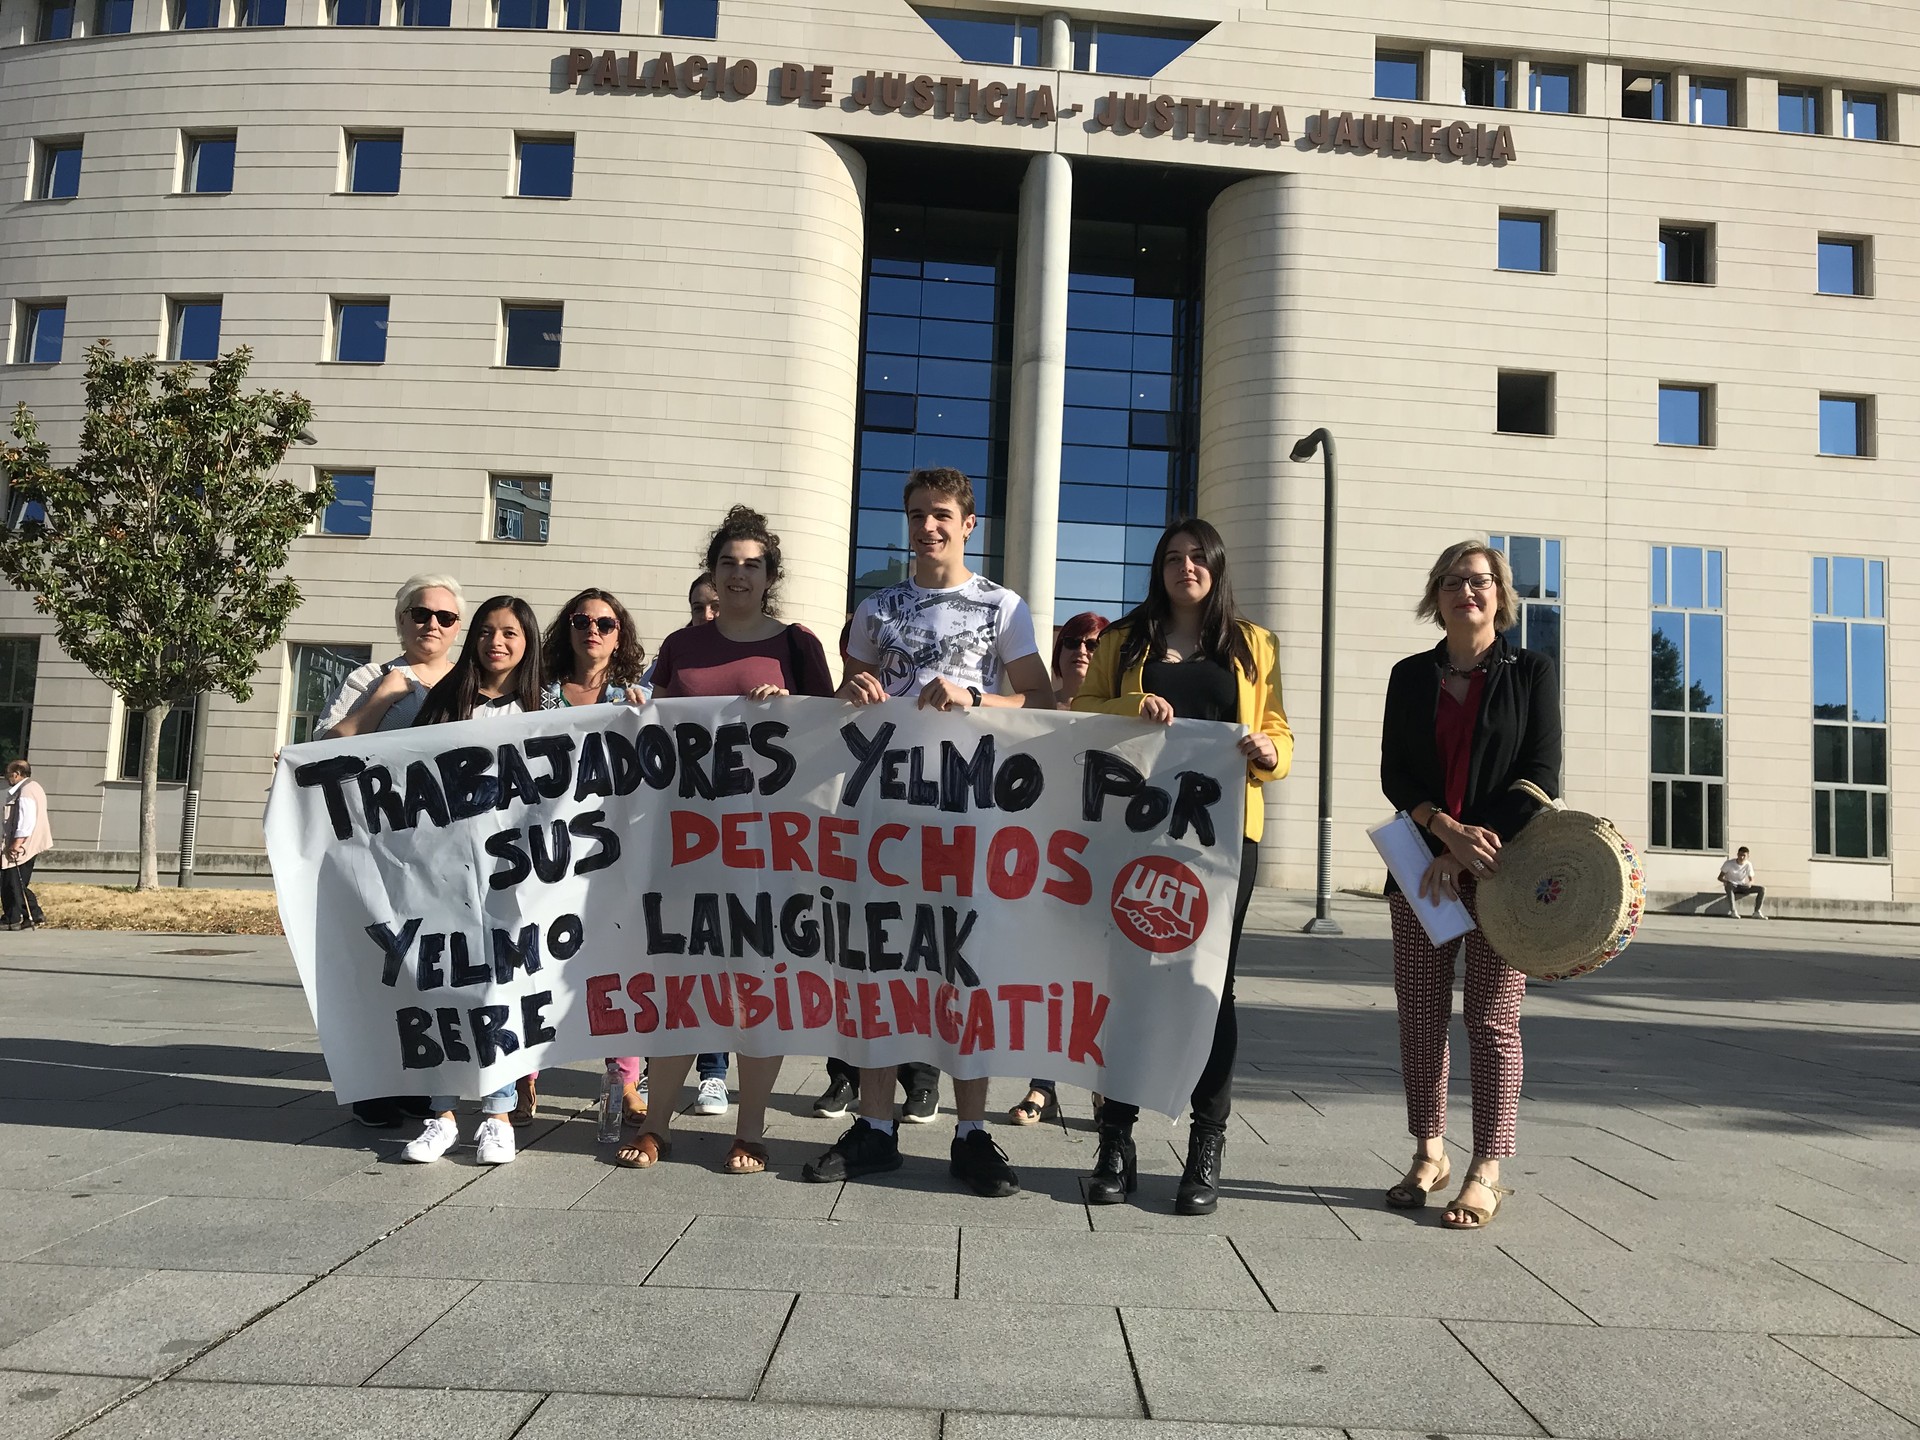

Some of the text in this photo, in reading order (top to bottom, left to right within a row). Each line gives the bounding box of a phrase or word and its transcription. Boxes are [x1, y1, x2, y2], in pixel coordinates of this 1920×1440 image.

[567, 47, 758, 97] PALACIO
[780, 62, 834, 103] DE
[854, 69, 1056, 122] JUSTICIA
[1099, 91, 1290, 142] JUSTIZIA
[1310, 109, 1517, 161] JAUREGIA
[295, 720, 797, 841] TRABAJADORES
[840, 721, 1045, 813] YELMO
[485, 810, 1093, 906] SUS DERECHOS
[1127, 864, 1201, 925] UGT
[364, 913, 585, 991] YELMO
[395, 990, 557, 1070] BERE
